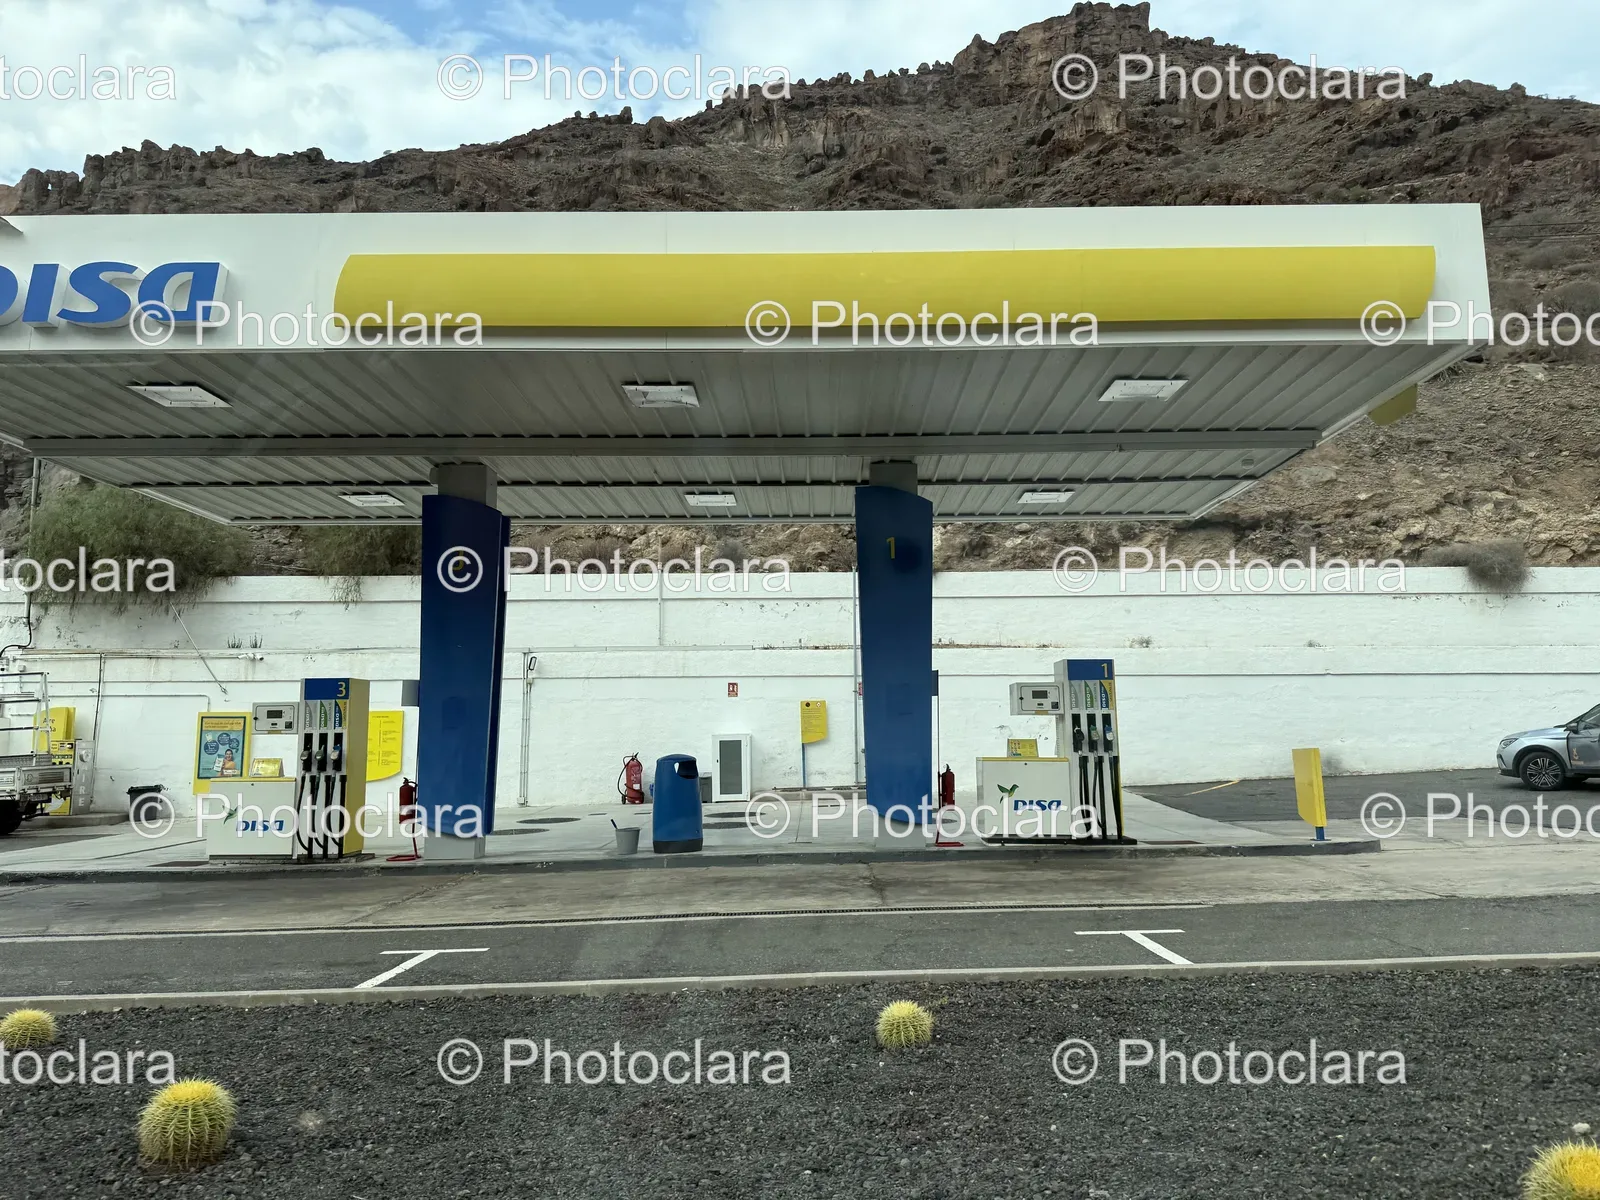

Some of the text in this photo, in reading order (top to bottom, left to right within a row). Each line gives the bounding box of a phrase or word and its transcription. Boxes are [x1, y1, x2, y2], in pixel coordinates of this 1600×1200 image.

[886, 536, 895, 559] 1
[1101, 663, 1108, 678] 1
[336, 681, 346, 697] 3
